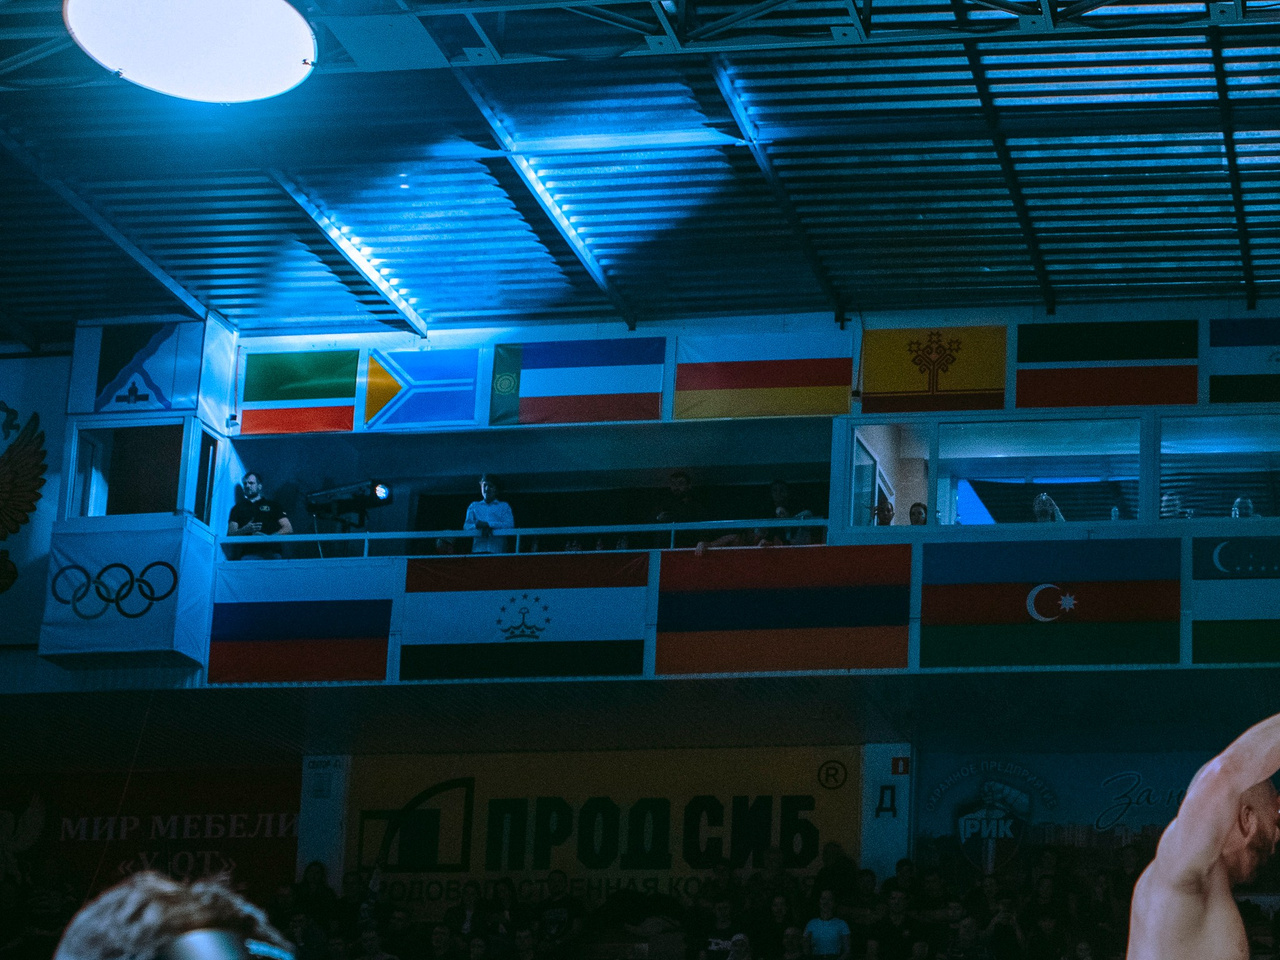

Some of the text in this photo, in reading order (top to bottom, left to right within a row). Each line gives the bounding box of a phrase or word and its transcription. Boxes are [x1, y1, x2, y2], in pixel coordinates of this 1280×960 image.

[59, 813, 298, 841] МИР МЕБЕЛИ
[966, 818, 1014, 838] РИК
